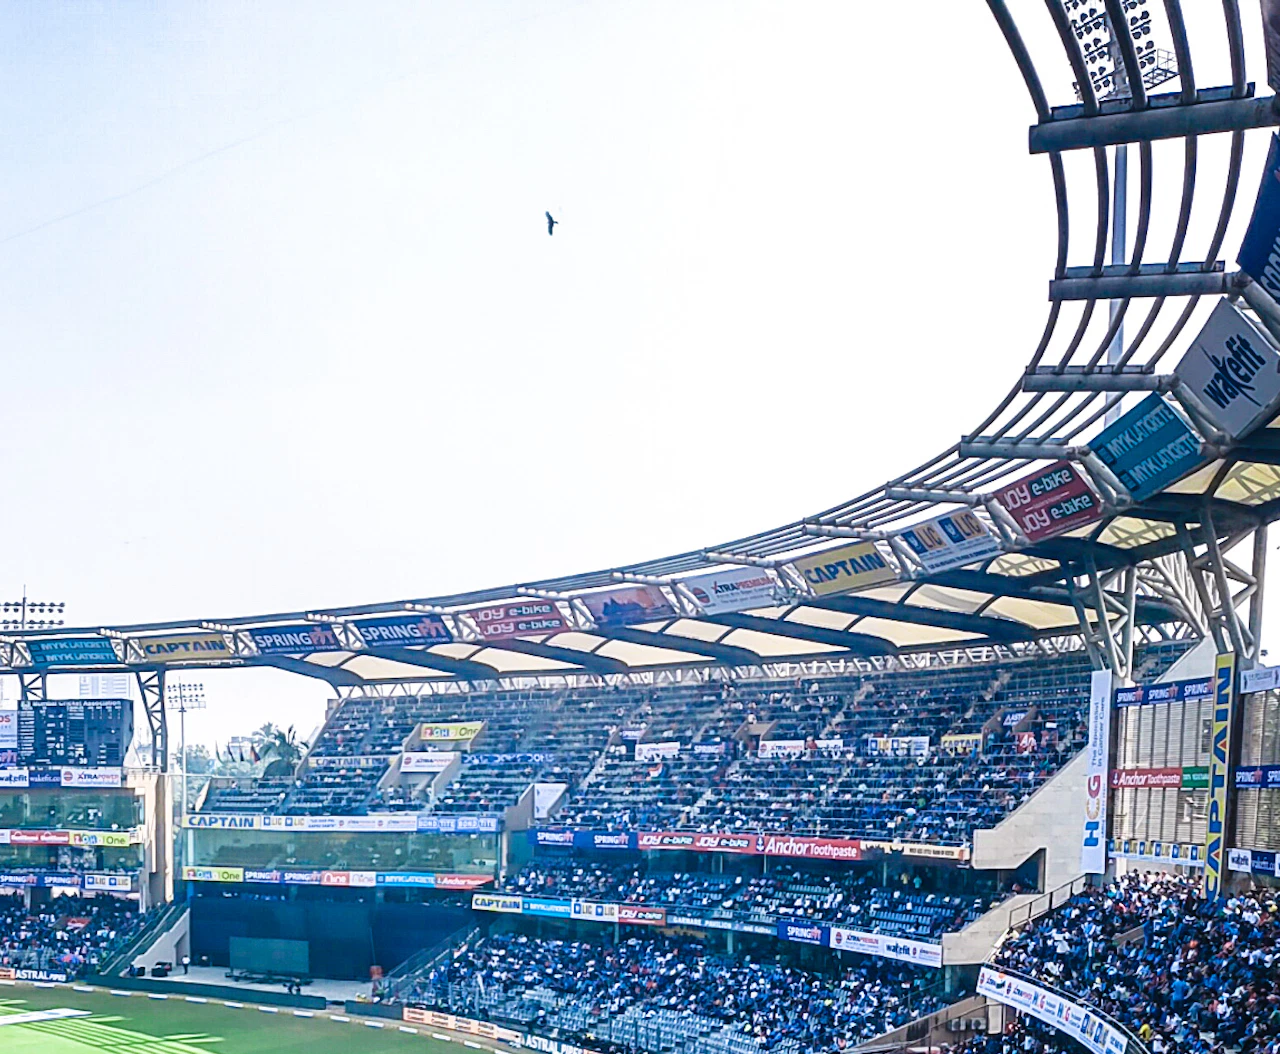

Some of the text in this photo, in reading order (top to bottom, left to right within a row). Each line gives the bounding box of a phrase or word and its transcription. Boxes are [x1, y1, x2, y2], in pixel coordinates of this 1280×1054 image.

[1198, 334, 1266, 411] wakefit
[1003, 468, 1073, 511] JOY e-bike
[958, 514, 981, 536] LIC
[1022, 493, 1093, 535] JOY e-bike
[917, 528, 941, 550] LIC
[804, 551, 886, 584] CAPTAIN
[474, 603, 552, 623] JOY e-bike
[255, 626, 335, 649] SPRINGFIT
[361, 616, 447, 642] SPRINGFIT
[483, 617, 561, 636] JOY e-bike
[146, 639, 226, 655] CAPTAIN
[1118, 771, 1148, 786] Anchor
[1147, 773, 1181, 785] Toothpaste
[1205, 666, 1232, 900] CAPTAIN
[1084, 774, 1101, 848] HCG
[188, 816, 254, 829] CAPTAIN
[639, 834, 662, 845] JOY
[696, 836, 720, 848] JOY
[765, 837, 857, 858] Anchor Toothpaste
[474, 897, 520, 909] CAPTAIN
